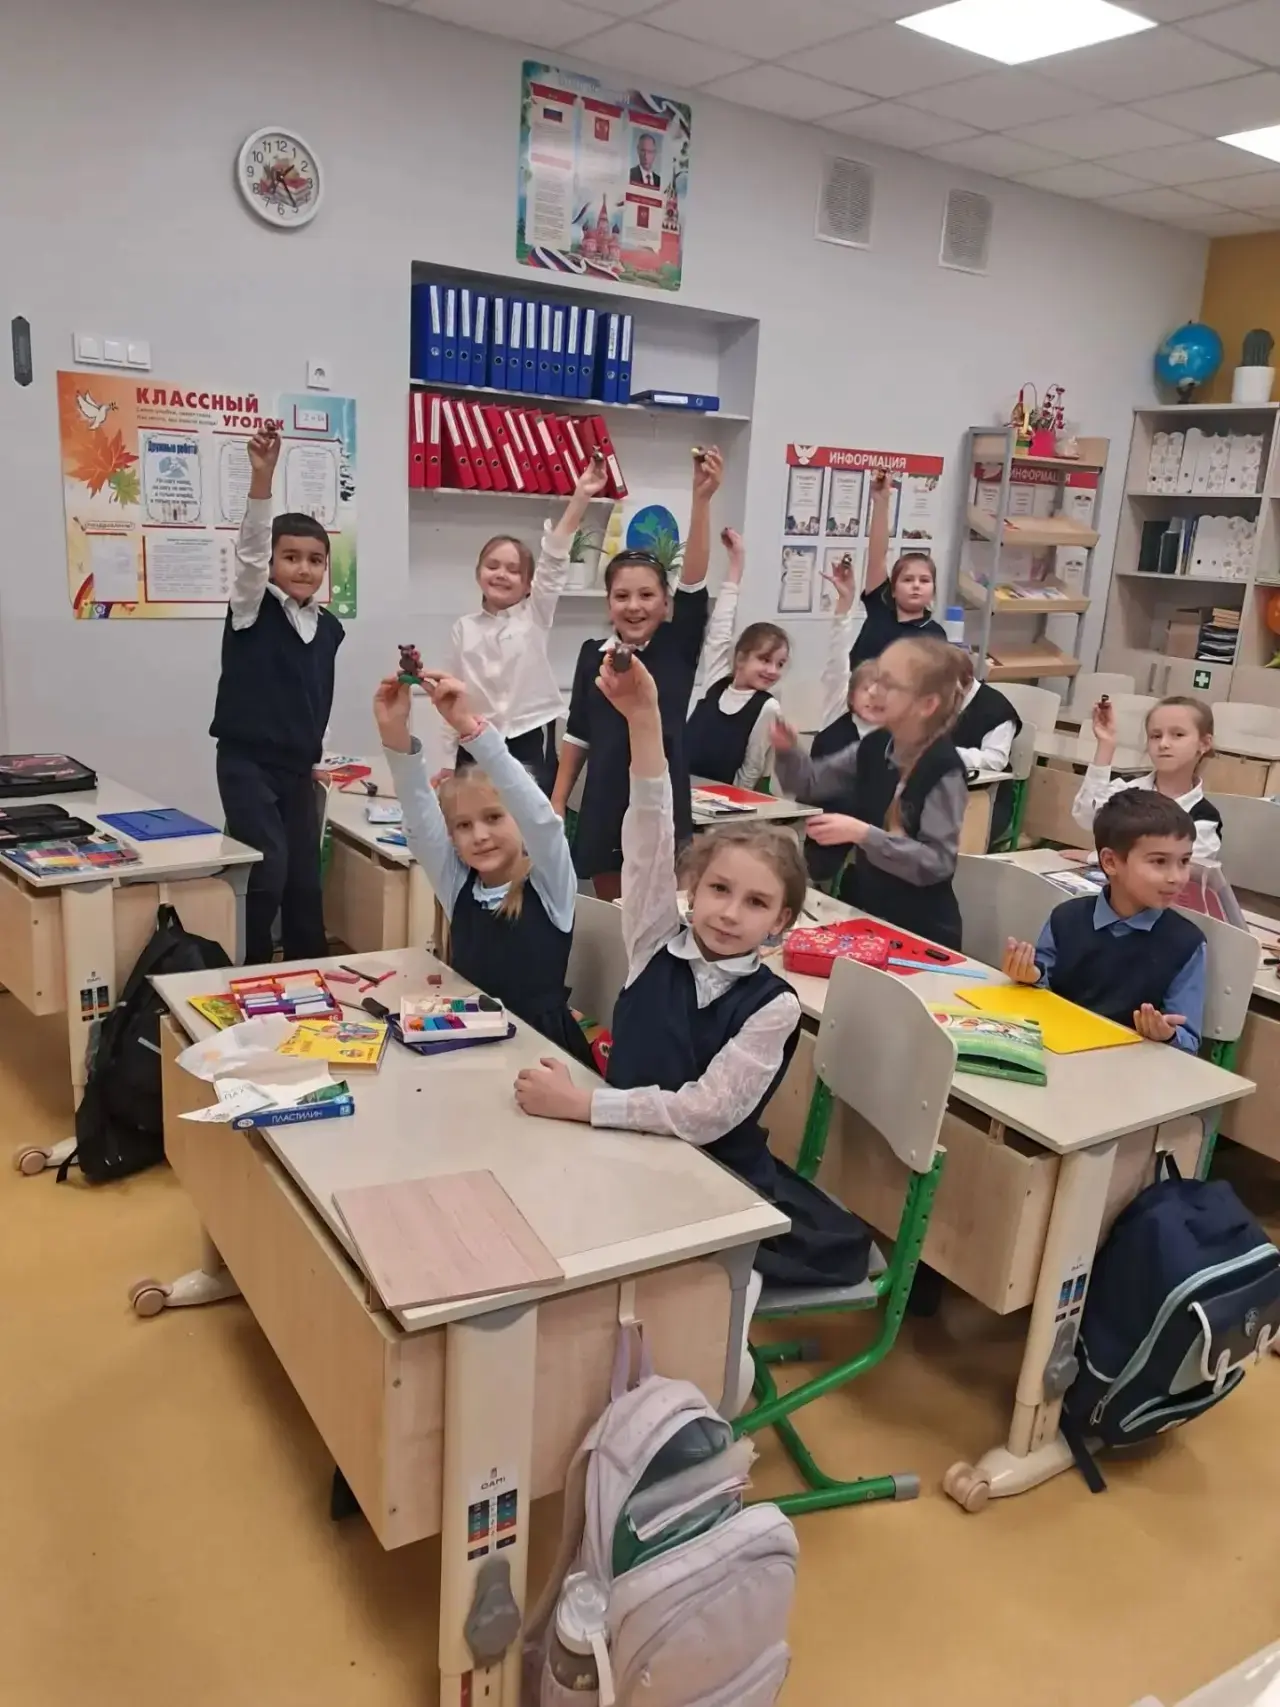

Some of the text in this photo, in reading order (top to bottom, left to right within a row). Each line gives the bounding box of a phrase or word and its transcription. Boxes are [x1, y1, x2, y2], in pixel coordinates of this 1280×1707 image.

[262, 140, 271, 153] 11
[276, 140, 287, 152] 12
[252, 150, 264, 163] 10
[292, 147, 296, 158] 1
[246, 165, 254, 177] 9
[301, 160, 308, 172] 2
[252, 182, 259, 194] 8
[306, 177, 313, 189] 3
[263, 196, 270, 207] 7
[277, 203, 285, 215] 6
[136, 387, 258, 413] КЛАССНЫЙ
[223, 414, 284, 430] УГОЛОК
[829, 451, 907, 469] ИНФОРМАЦИЯ
[1011, 467, 1070, 484] ИНФОРМАЦЯ
[271, 1111, 323, 1123] ПЛАСТИЛИН
